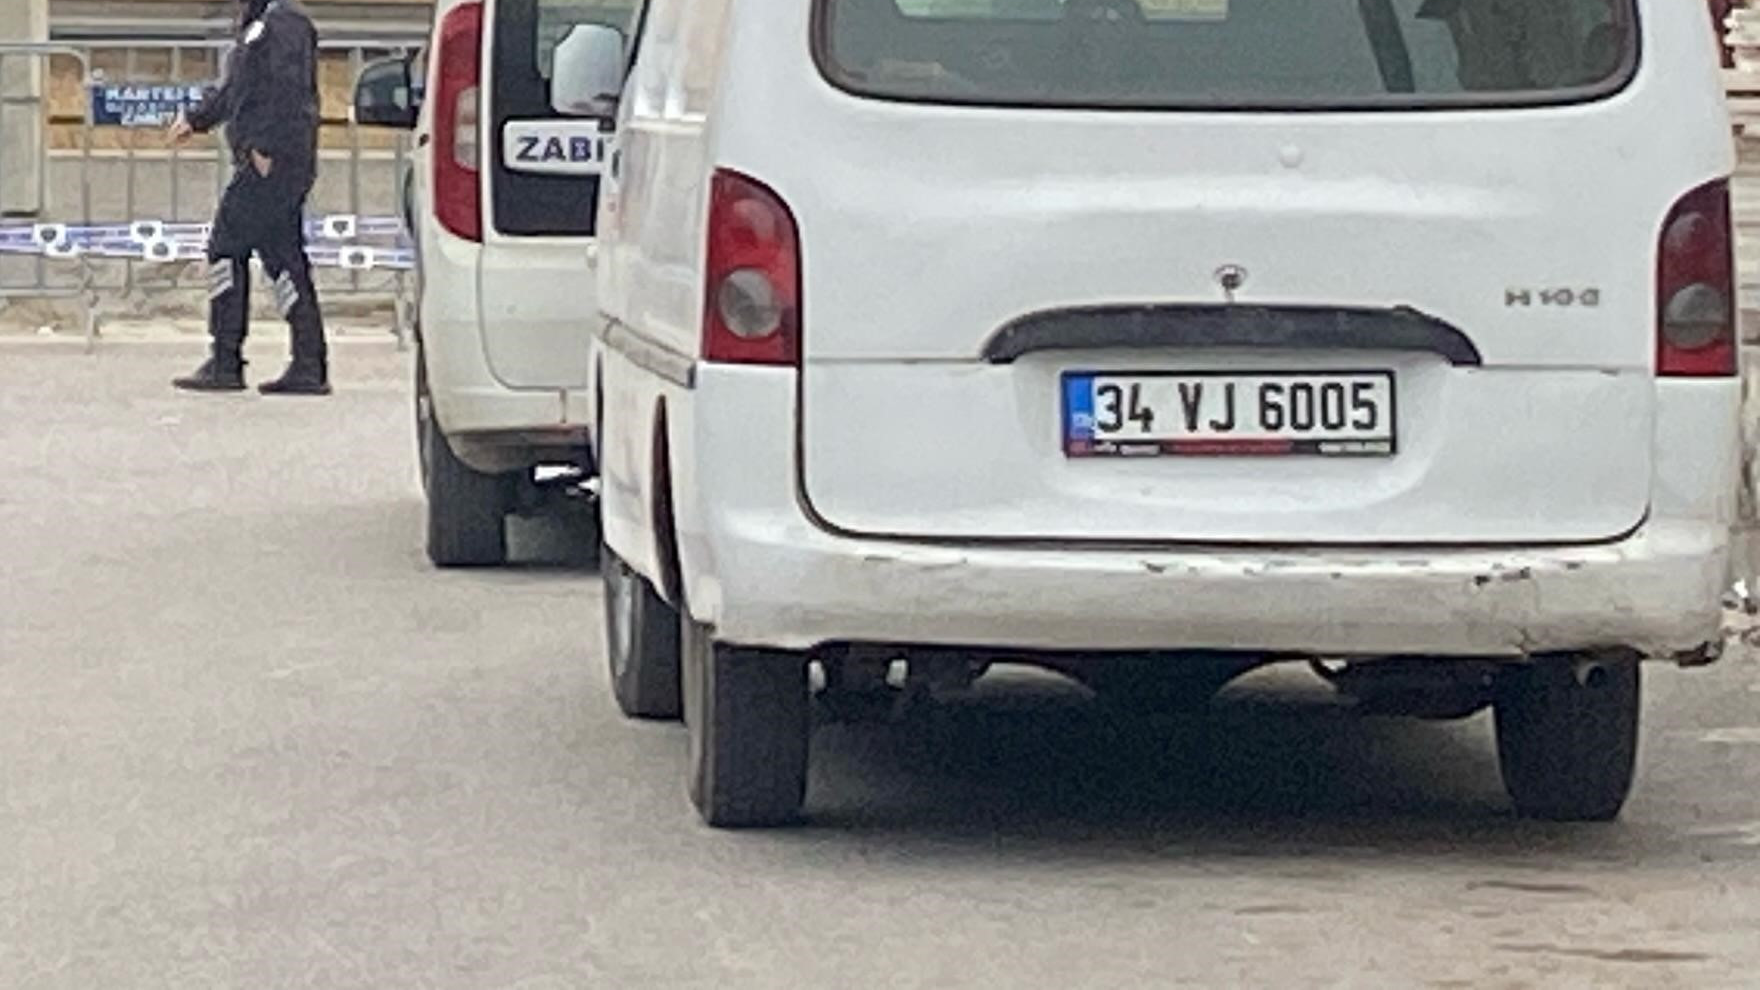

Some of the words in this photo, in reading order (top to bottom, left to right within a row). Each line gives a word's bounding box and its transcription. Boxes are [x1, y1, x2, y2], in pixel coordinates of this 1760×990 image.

[515, 136, 605, 162] ZABI
[1096, 383, 1154, 432] 34
[1178, 382, 1235, 431] VJ
[1258, 381, 1378, 431] 6005
